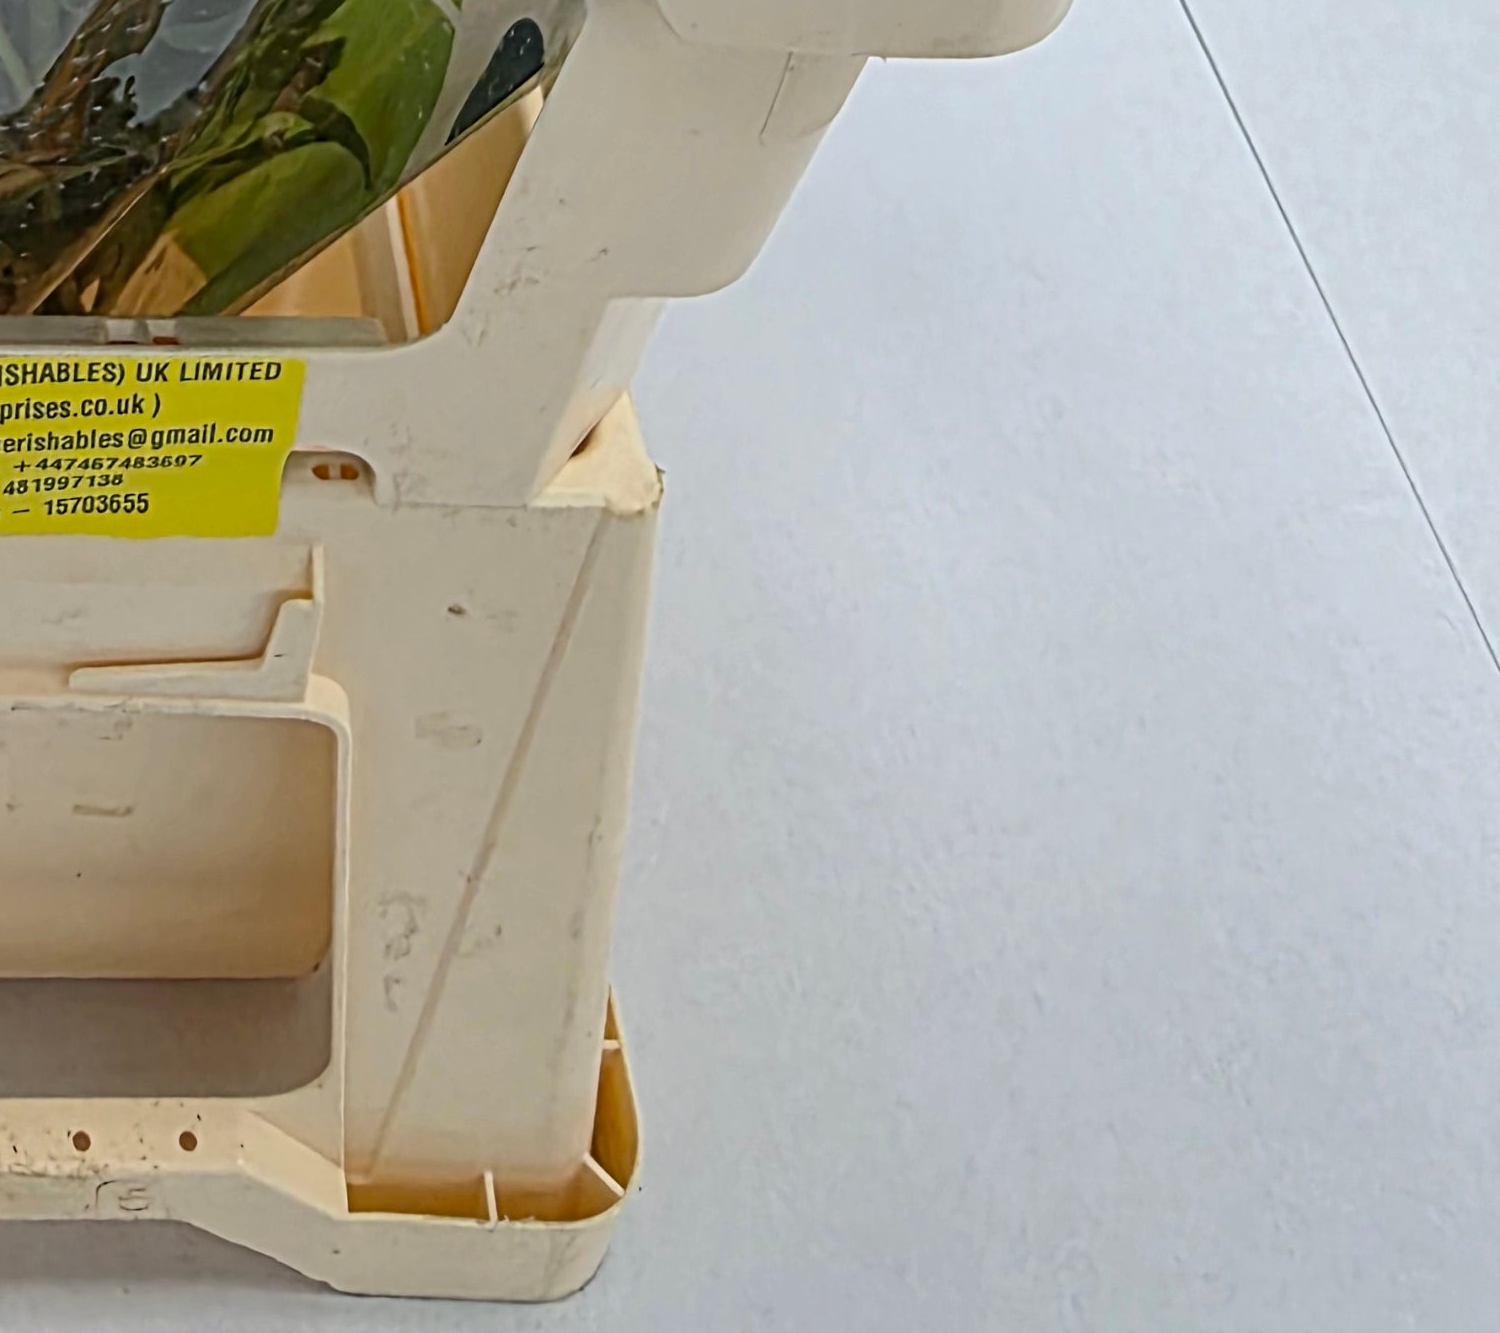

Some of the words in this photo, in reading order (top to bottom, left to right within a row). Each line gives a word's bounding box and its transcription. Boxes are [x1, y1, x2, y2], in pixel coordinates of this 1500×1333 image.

[136, 362, 169, 382] UK
[179, 361, 282, 381] LIMITED
[151, 393, 161, 418] )
[44, 493, 150, 516] 15703655
